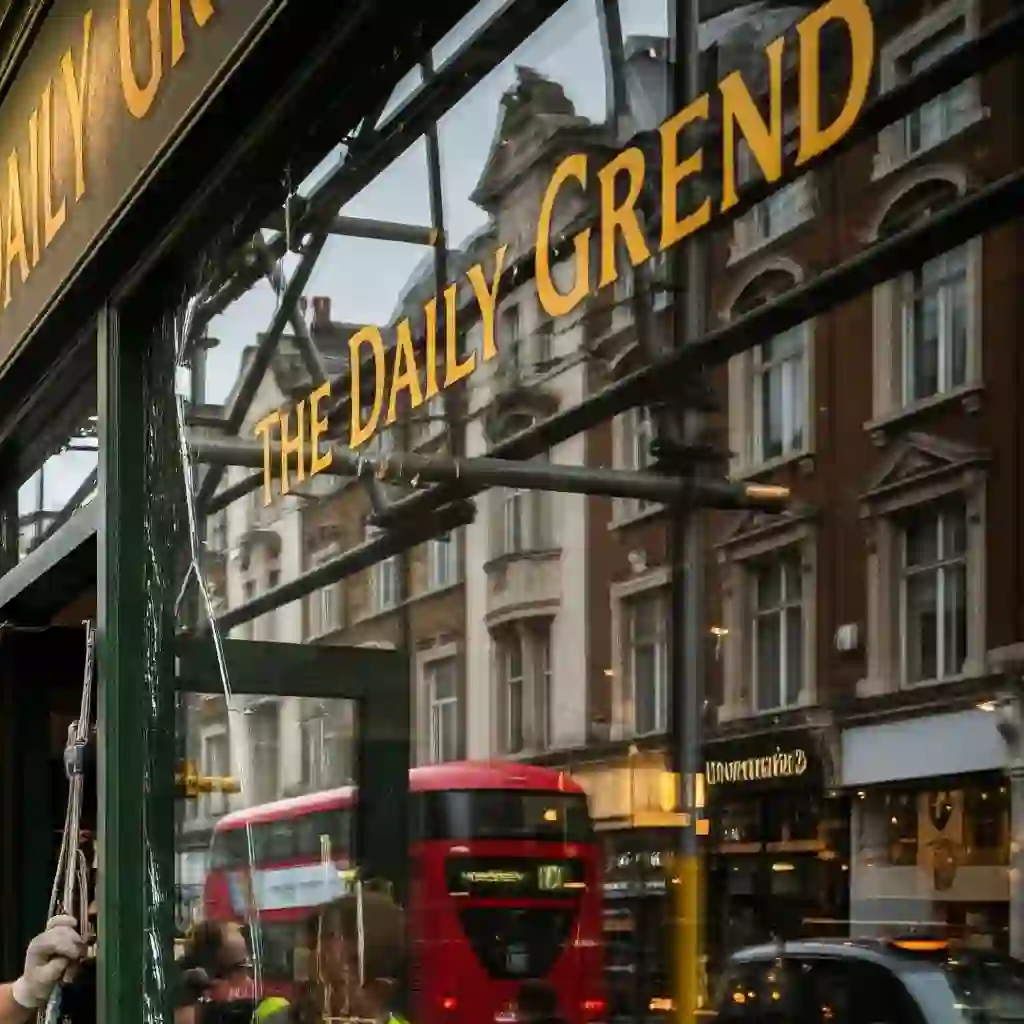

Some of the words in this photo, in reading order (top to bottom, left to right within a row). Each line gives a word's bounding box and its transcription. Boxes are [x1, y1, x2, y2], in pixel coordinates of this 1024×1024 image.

[255, 381, 333, 506] THE
[348, 243, 507, 449] DAILY
[535, 0, 875, 317] GREND
